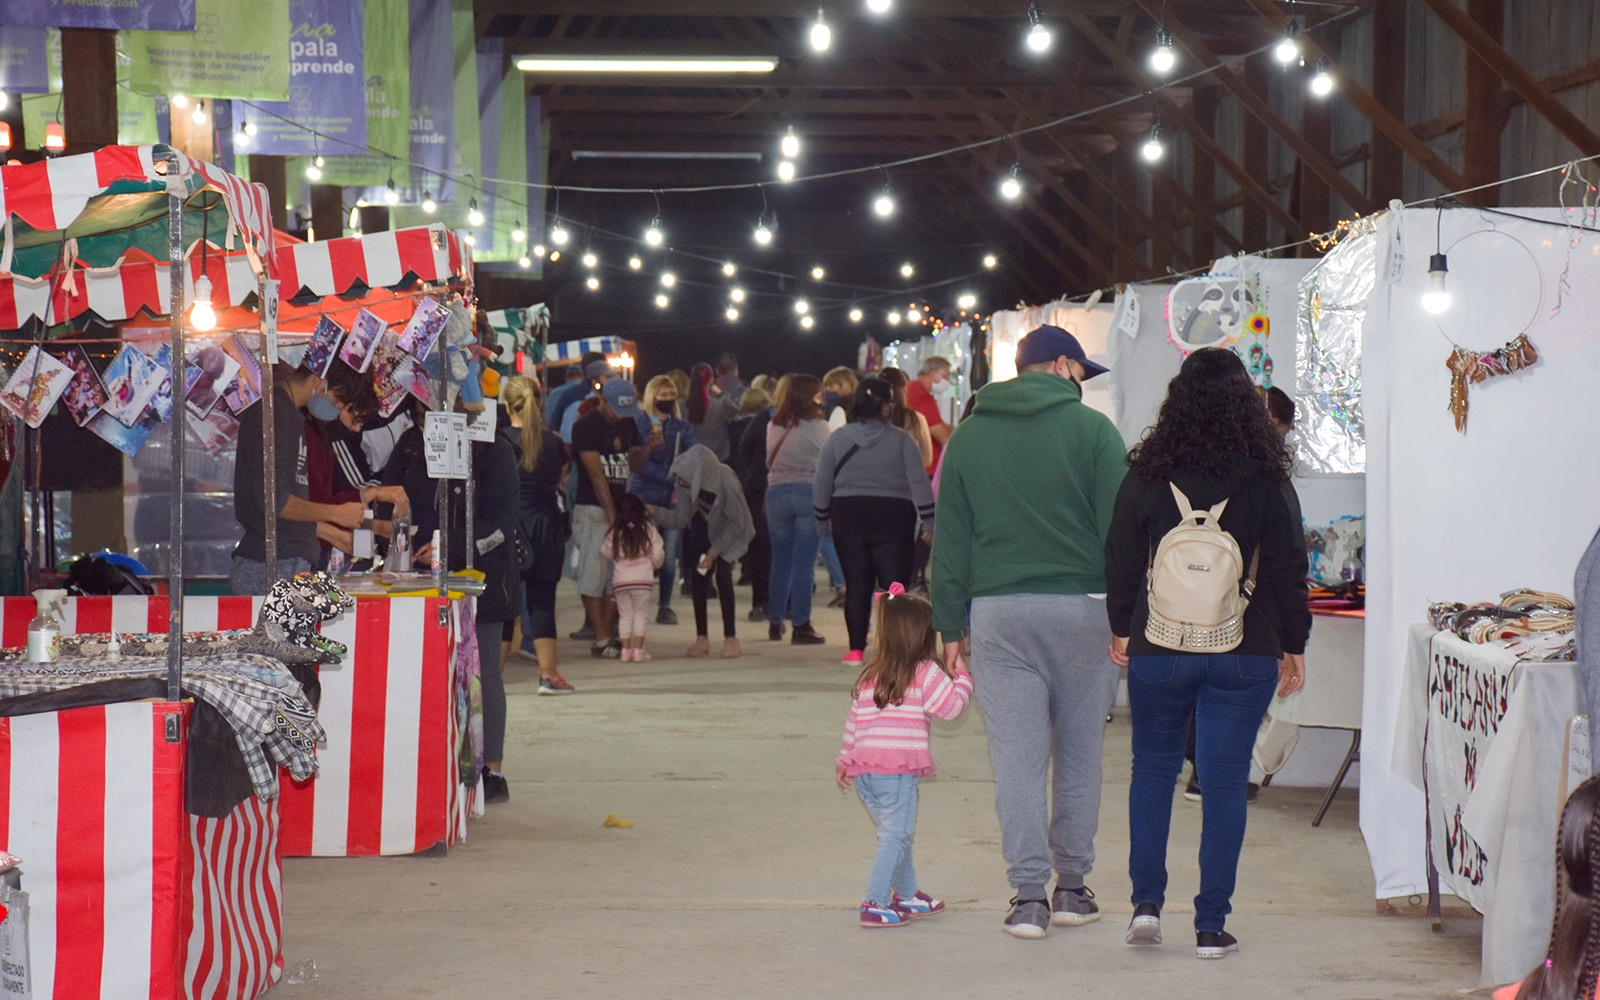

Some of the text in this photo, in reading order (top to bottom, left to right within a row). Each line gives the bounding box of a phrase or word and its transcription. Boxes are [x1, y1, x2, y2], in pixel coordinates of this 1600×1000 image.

[290, 38, 338, 61] pala
[290, 60, 355, 76] prende
[366, 107, 400, 118] ende
